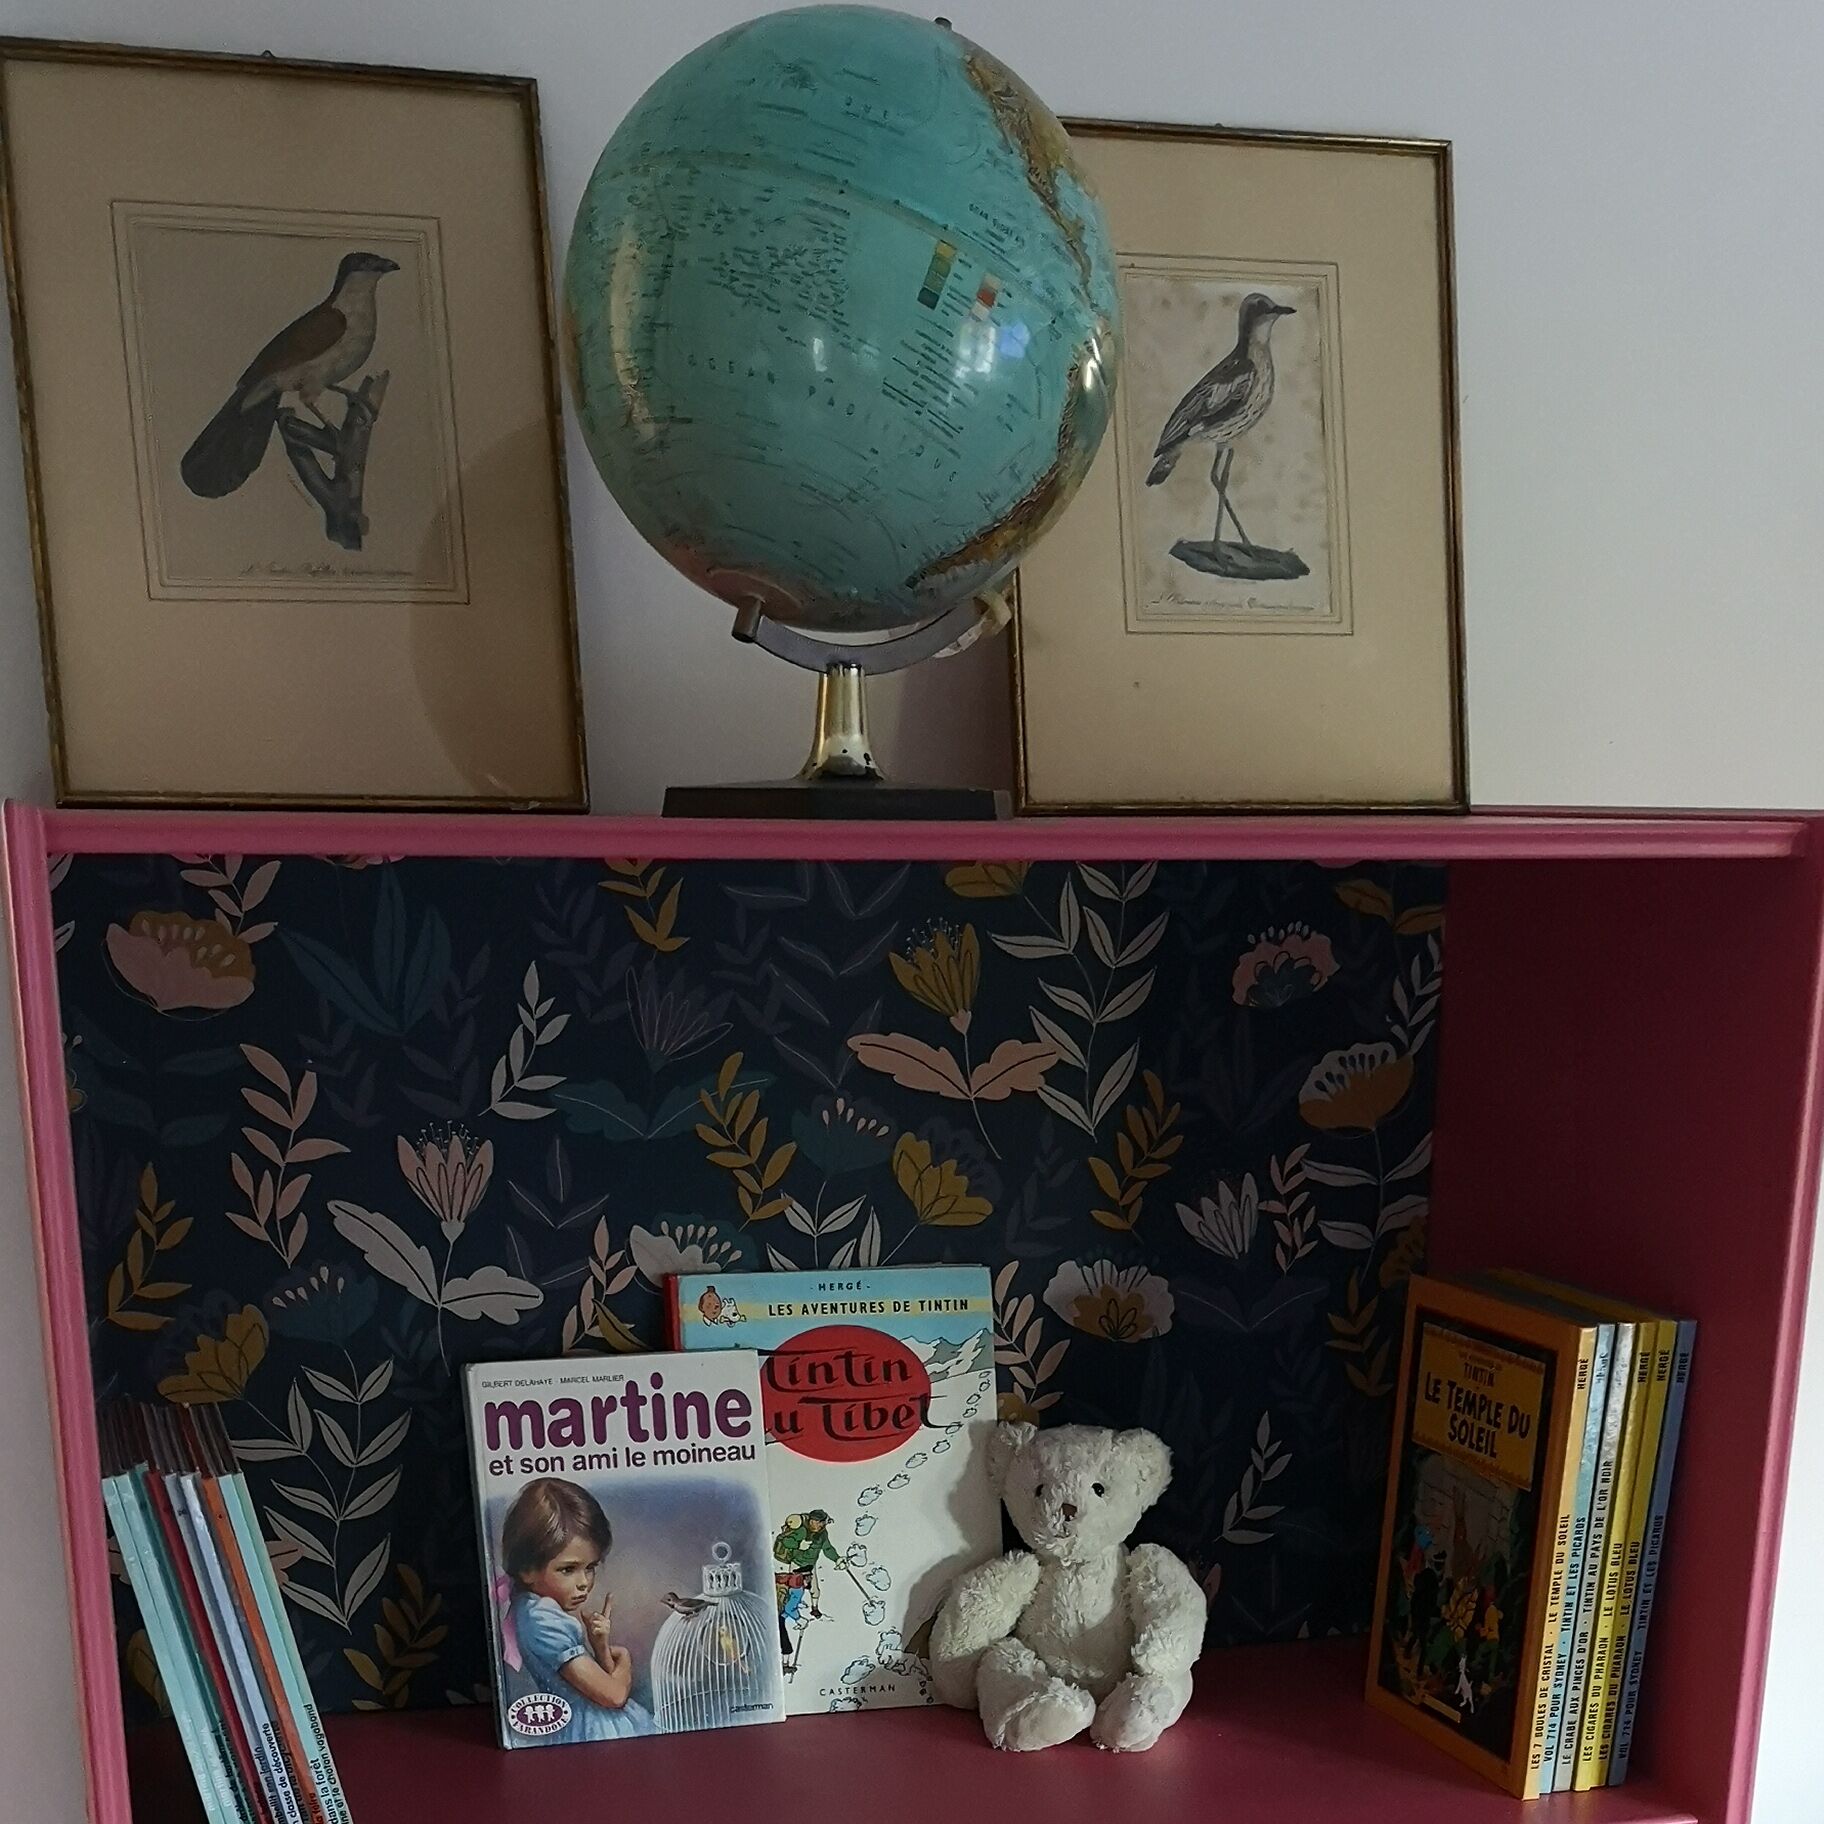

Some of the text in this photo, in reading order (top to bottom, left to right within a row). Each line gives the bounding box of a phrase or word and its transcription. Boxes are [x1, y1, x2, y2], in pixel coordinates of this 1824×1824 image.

[818, 1279, 862, 1291] HERGÉ
[768, 1299, 969, 1316] LES AVENTURES DE TINTIN
[481, 1380, 513, 1389] GILBERT
[559, 1374, 625, 1384] MARCEL MARLIER
[1463, 1361, 1495, 1387] TINTIN
[484, 1371, 752, 1451] martine
[797, 1392, 957, 1441] Tibet
[1424, 1372, 1531, 1439] LE TEMPLE DU
[1448, 1413, 1498, 1458] SOLEIL
[488, 1442, 755, 1476] et son ami le moineau
[1583, 1460, 1613, 1613] TINTIN AU PAYS DE L'OR NOIR
[1548, 1514, 1570, 1623] LE TEMPLE DU SOLEIL
[1561, 1516, 1586, 1633] TINTIN ET LES PICAROS
[1603, 1543, 1623, 1617] LE LOTUS BLEU
[1620, 1541, 1640, 1616] LE LOTUS BLEU
[1642, 1583, 1652, 1594] ET
[1541, 1643, 1554, 1681] CRISTAL
[1554, 1653, 1567, 1688] SYDNEY
[1611, 1635, 1626, 1679] PHARAON
[819, 1684, 896, 1696] CASTERMAN
[1540, 1687, 1549, 1698] DE
[1562, 1631, 1589, 1765] LE CRABE AUX PINCES D'OR
[1582, 1637, 1609, 1762] LES CIGARES DU PHARAON
[1608, 1684, 1618, 1696] DU
[730, 1702, 774, 1713] casterman
[1549, 1693, 1561, 1718] POUR
[304, 1703, 326, 1752] vagabond
[262, 1722, 283, 1774] découverte
[1531, 1753, 1541, 1770] LES
[1543, 1745, 1554, 1762] VOL
[1598, 1743, 1609, 1760] LES
[278, 1776, 288, 1788] de
[310, 1757, 326, 1786] forêt
[321, 1753, 337, 1785] chaton
[283, 1790, 297, 1818] classe
[309, 1792, 321, 1814] foire
[320, 1786, 330, 1799] la
